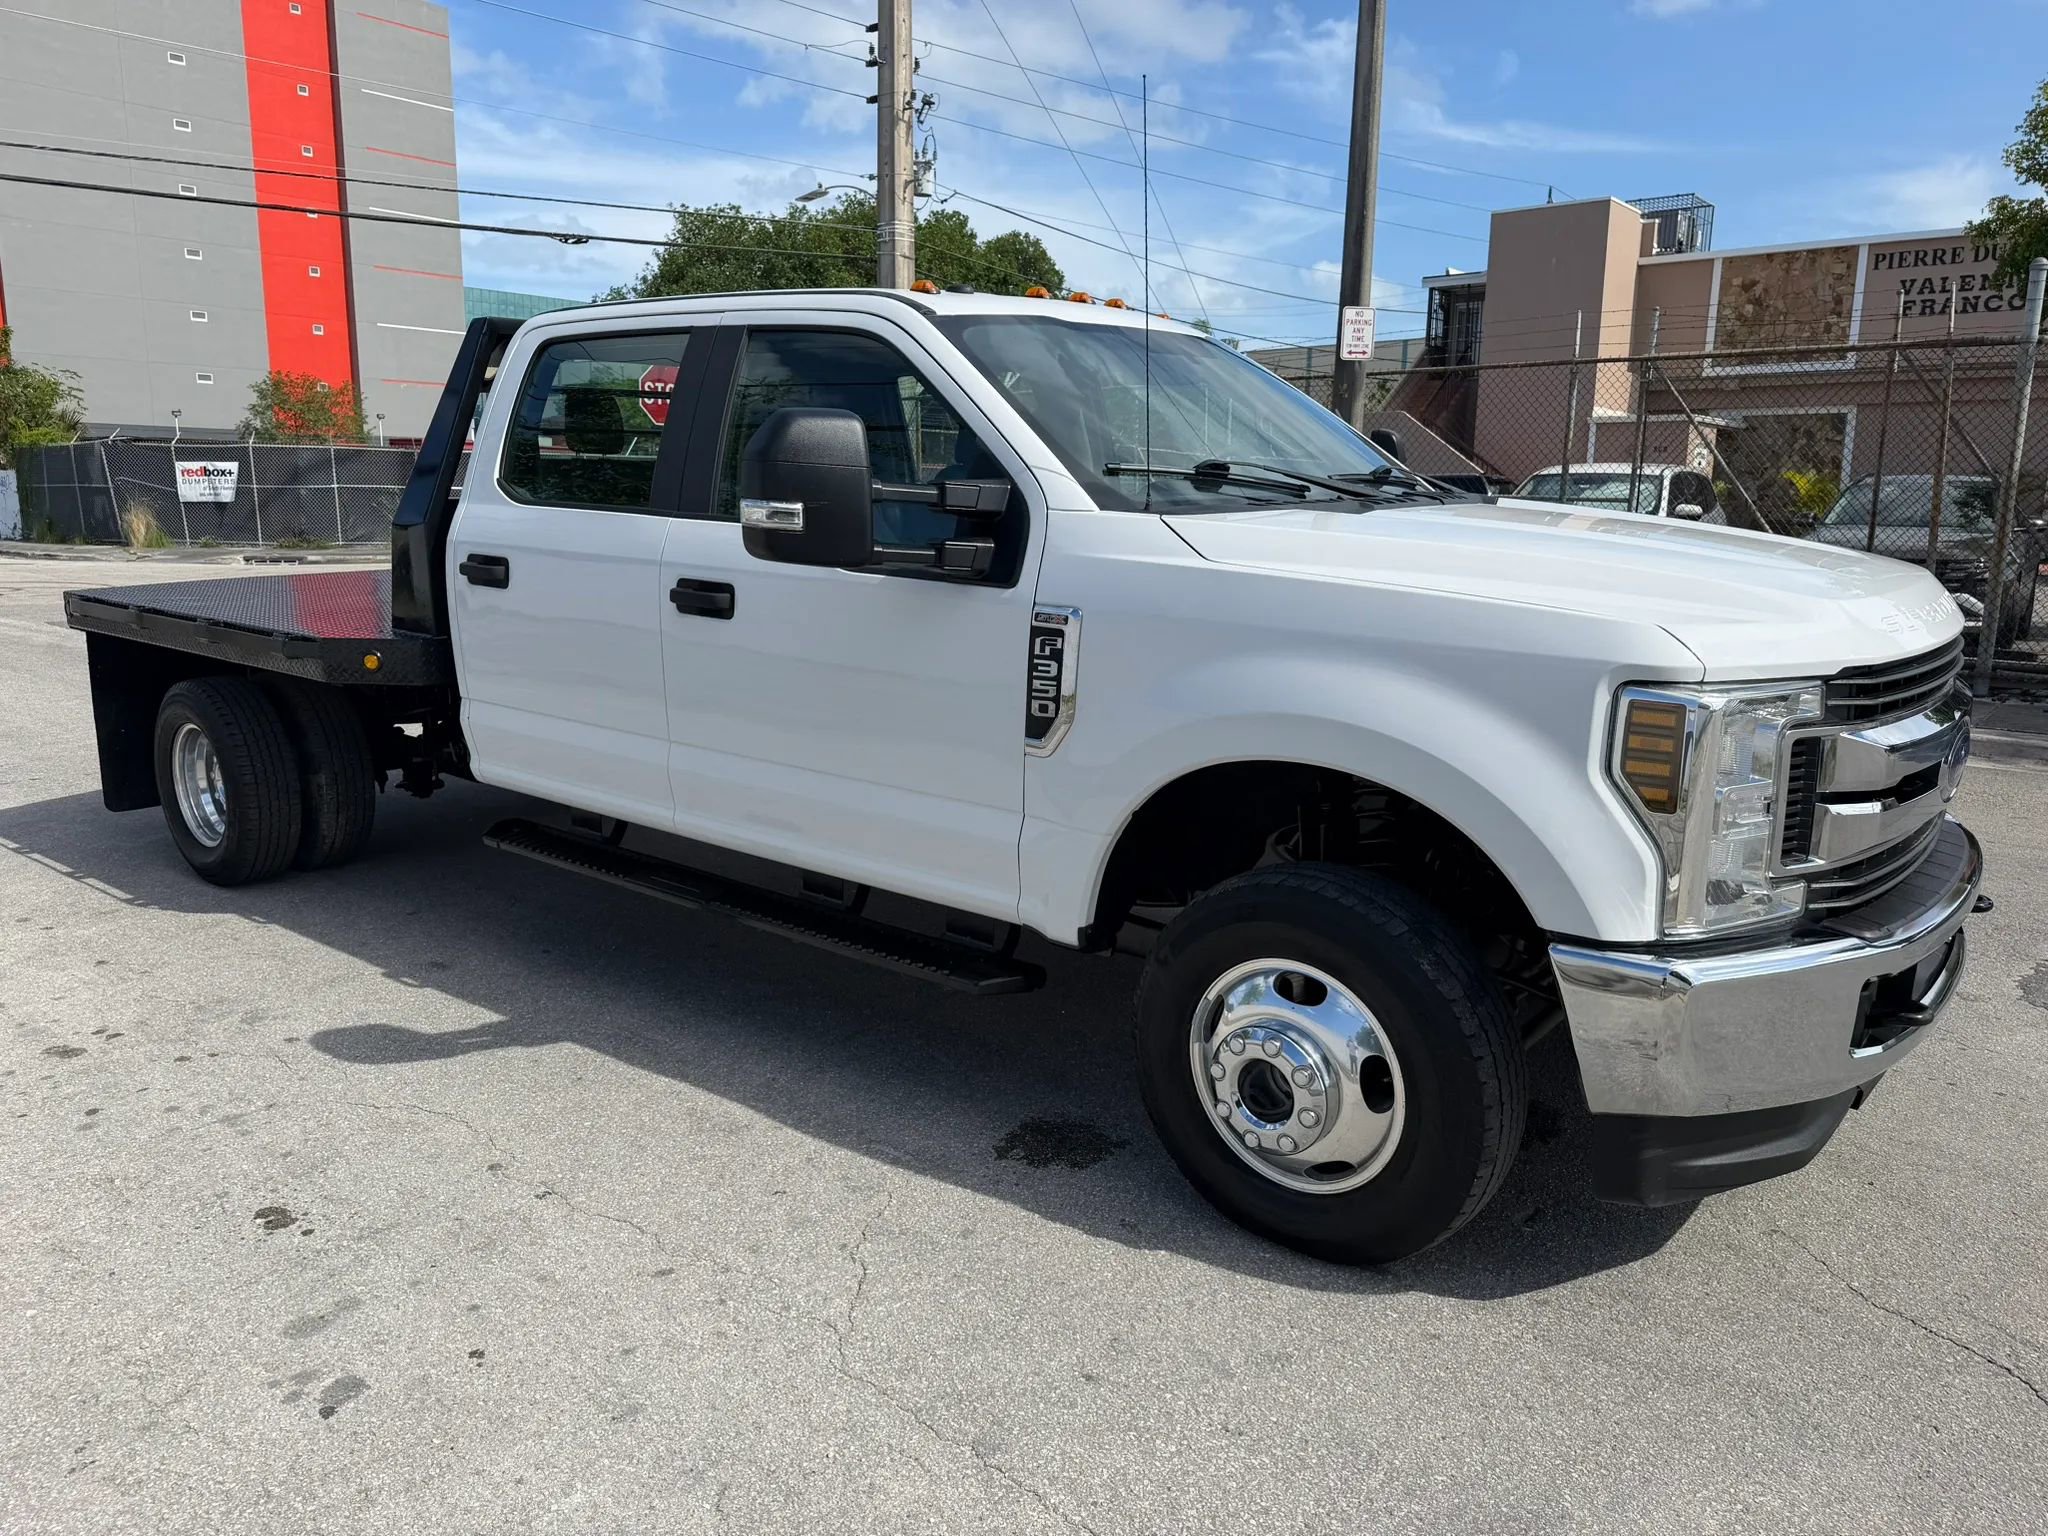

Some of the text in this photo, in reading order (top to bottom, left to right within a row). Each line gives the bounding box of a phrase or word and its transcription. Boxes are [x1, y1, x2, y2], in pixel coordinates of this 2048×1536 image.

[1872, 246, 1965, 271] PIERRE
[1354, 310, 1365, 318] NO
[1345, 319, 1373, 327] PARKING
[1351, 335, 1366, 343] TIME
[180, 465, 235, 478] redbox+
